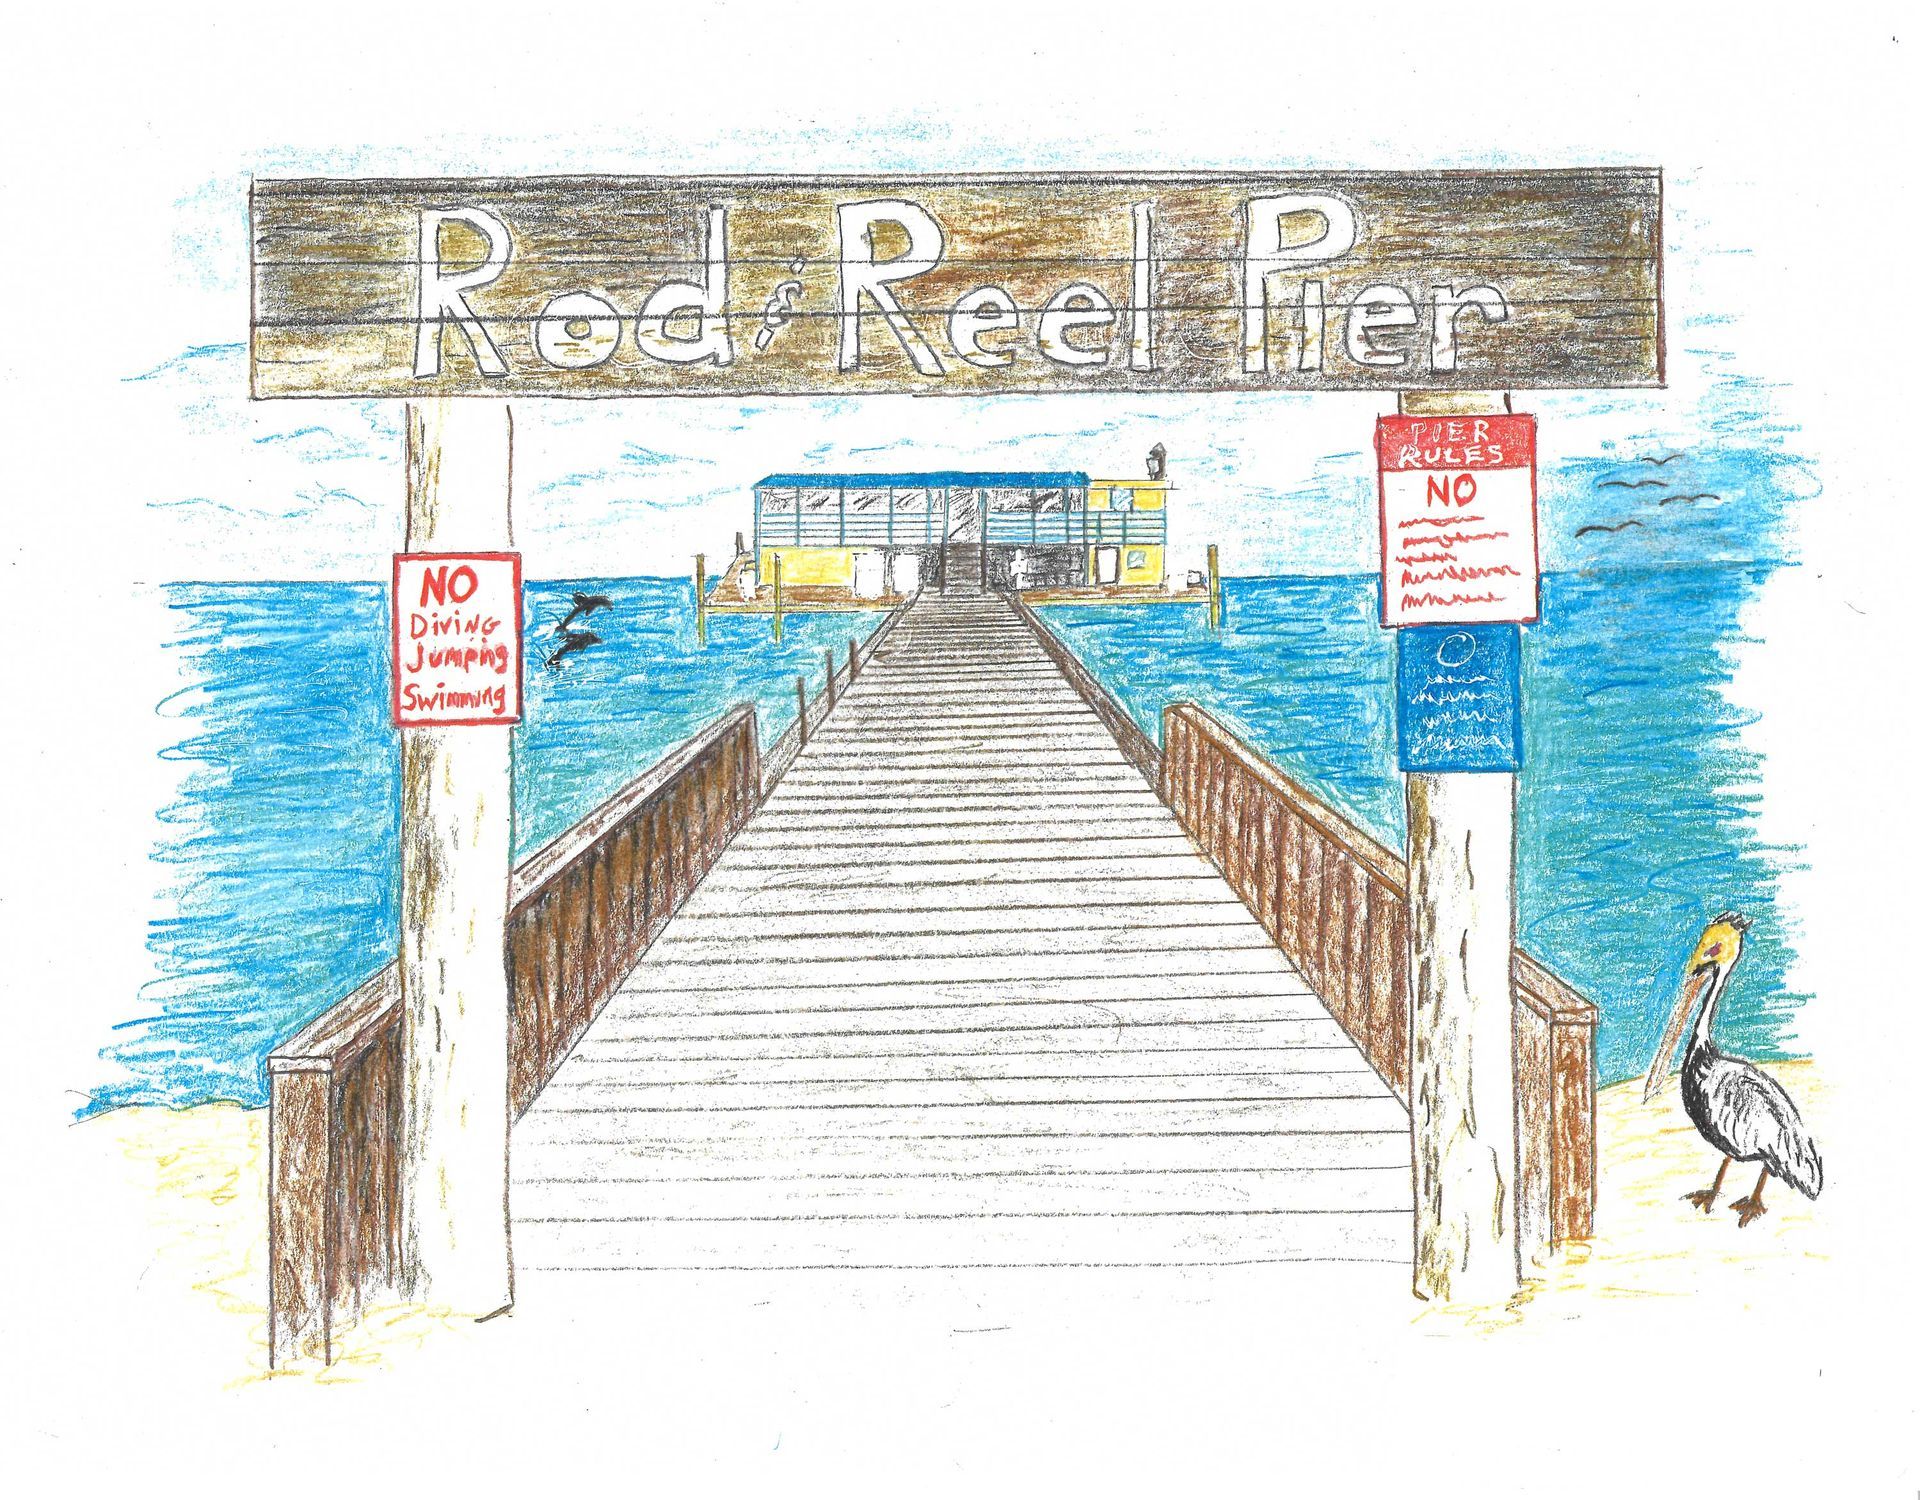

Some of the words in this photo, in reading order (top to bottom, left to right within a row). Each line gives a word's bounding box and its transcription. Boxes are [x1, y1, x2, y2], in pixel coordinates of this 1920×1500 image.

[413, 203, 735, 379] Rod
[837, 199, 1161, 376] Reel
[1240, 191, 1513, 375] Pier
[1410, 419, 1490, 445] PIER
[1398, 444, 1504, 468] RULES
[1427, 473, 1477, 507] NO
[420, 565, 478, 608] NO
